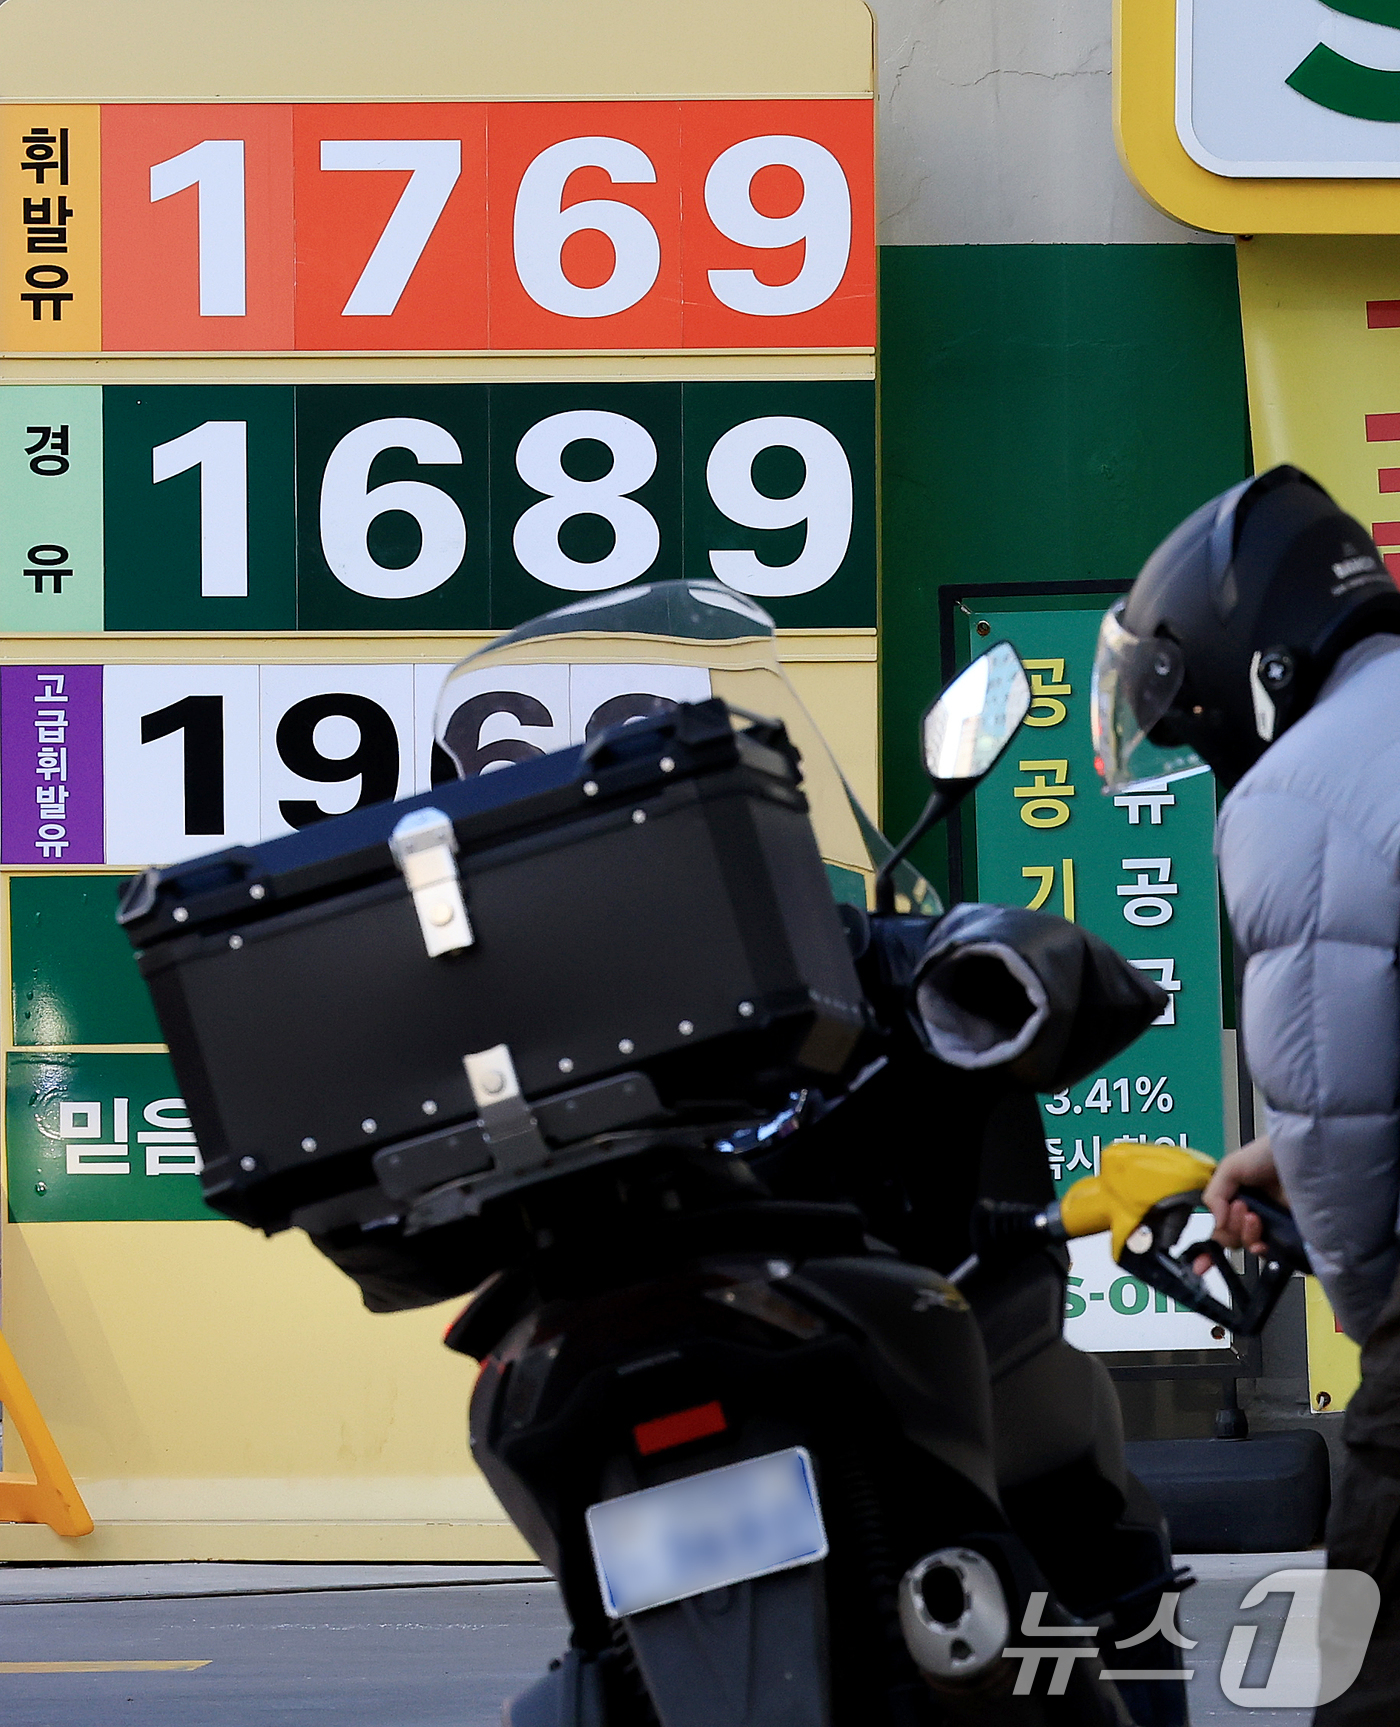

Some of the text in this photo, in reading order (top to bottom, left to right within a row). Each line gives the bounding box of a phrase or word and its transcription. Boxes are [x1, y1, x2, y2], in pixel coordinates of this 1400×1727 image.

[20, 127, 74, 321] 휘발유
[149, 134, 852, 319] 1769
[152, 410, 854, 600] 1689
[34, 674, 69, 858] 고급휘발유
[1044, 1076, 1174, 1115] 3.41%
[1064, 1275, 1197, 1319] S-OI
